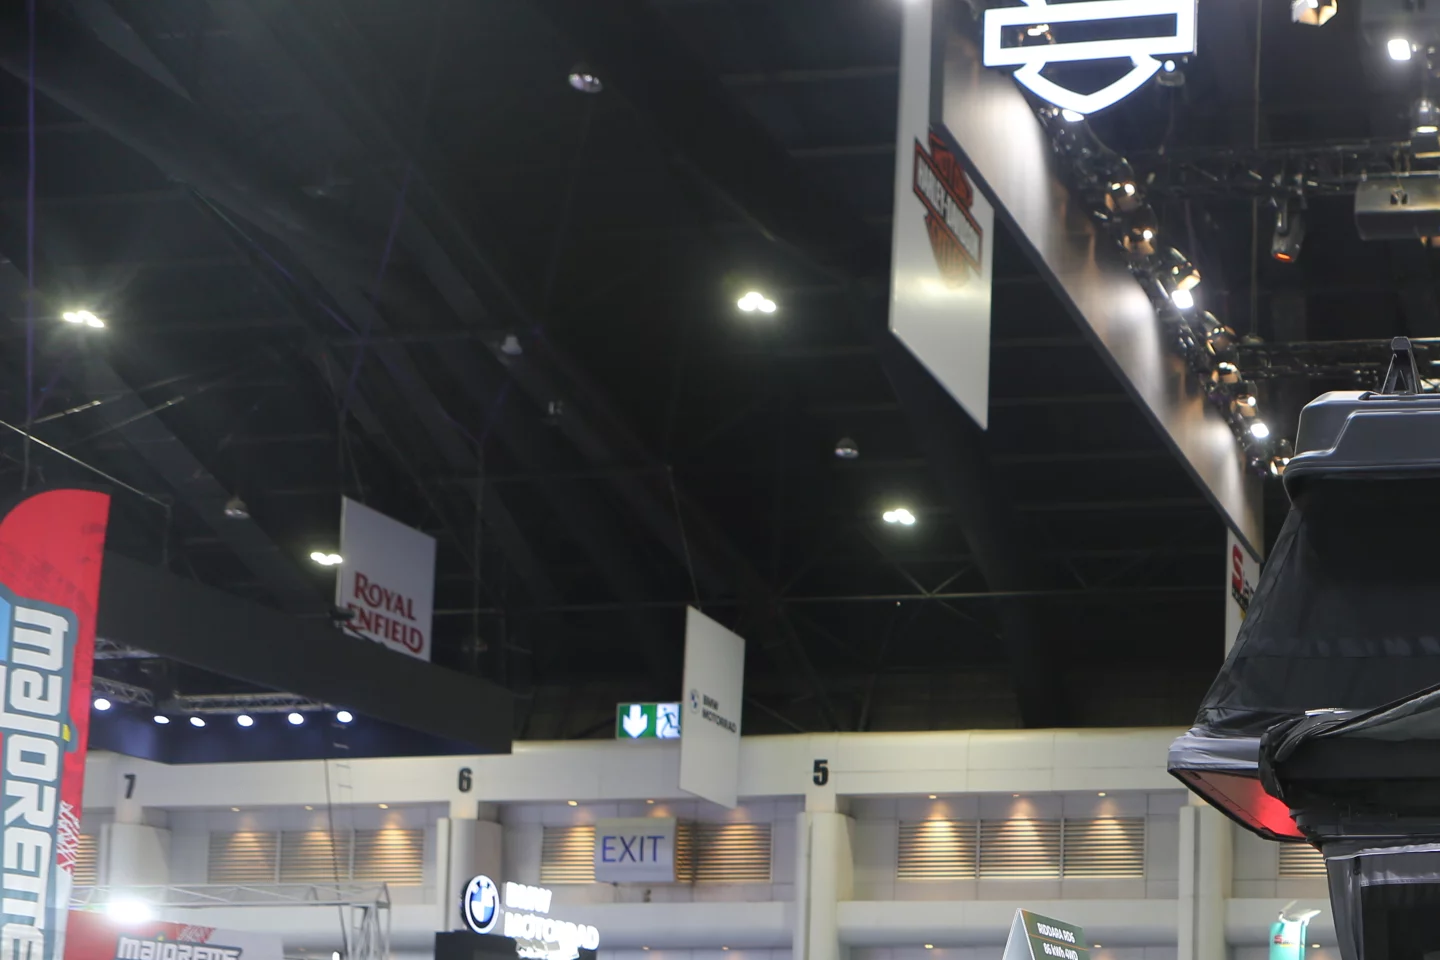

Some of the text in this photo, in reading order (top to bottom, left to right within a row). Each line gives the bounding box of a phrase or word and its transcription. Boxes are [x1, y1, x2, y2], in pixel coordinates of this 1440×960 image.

[354, 571, 417, 622] ROYAL
[125, 774, 136, 798] 7
[458, 767, 473, 794] 6
[812, 759, 829, 786] 5
[601, 835, 665, 864] EXIT
